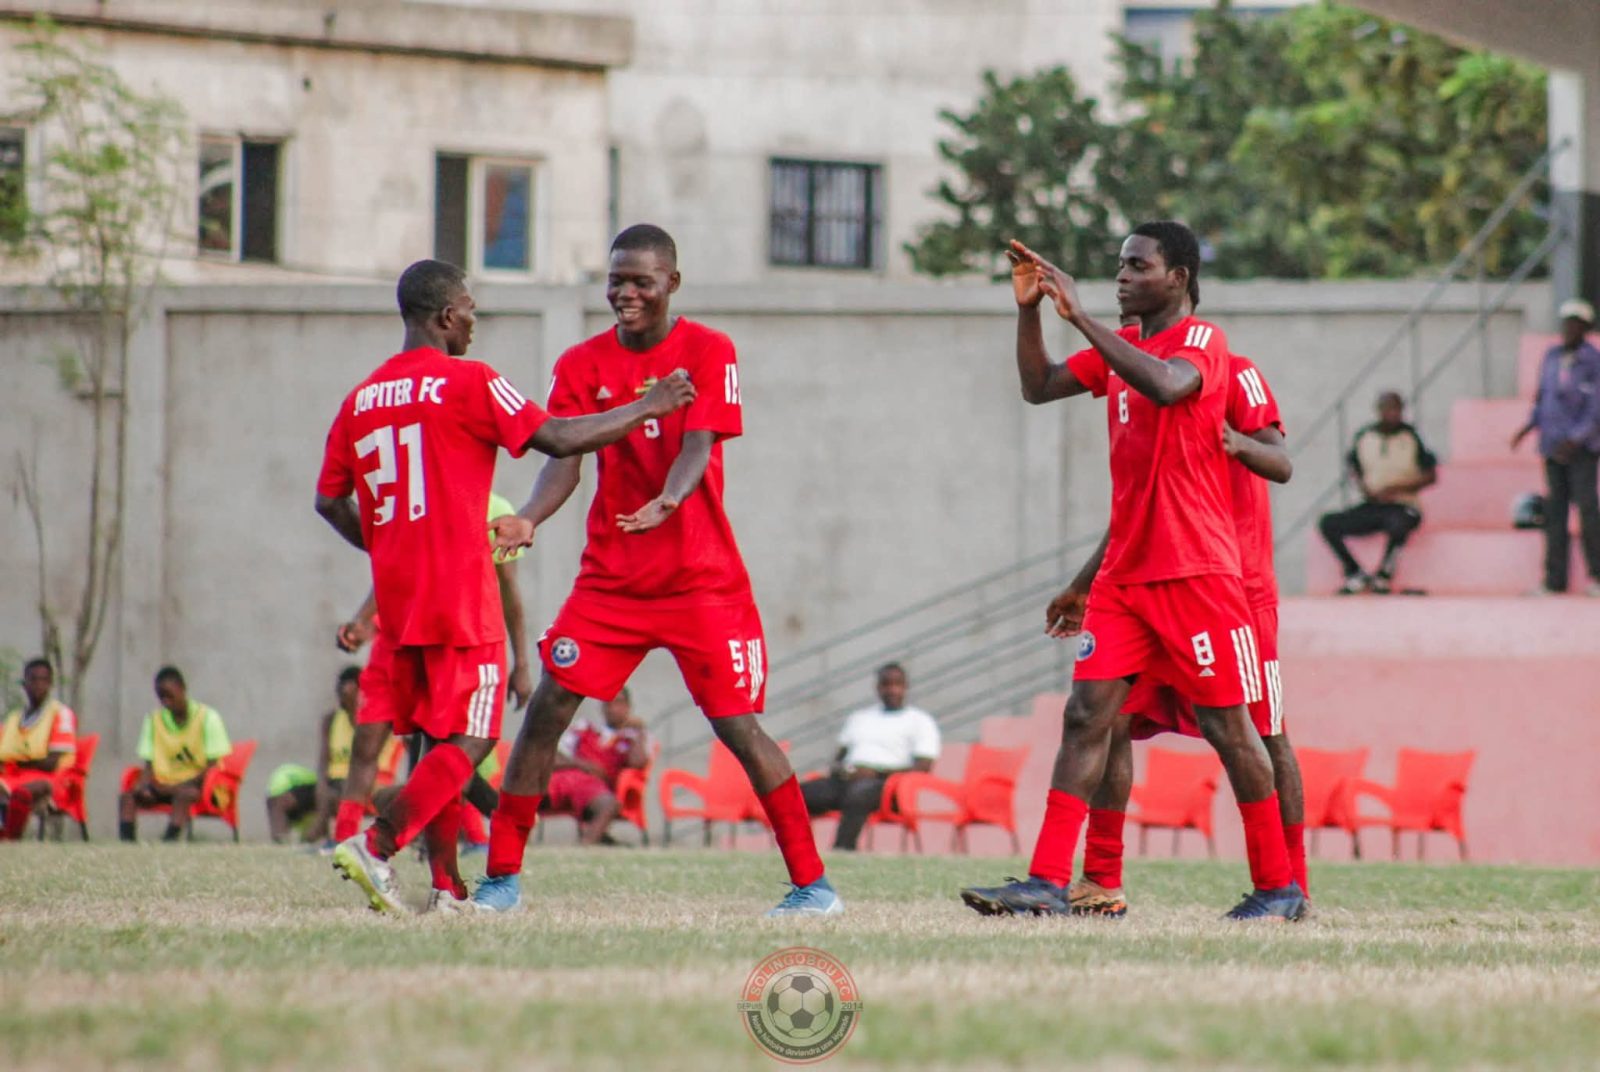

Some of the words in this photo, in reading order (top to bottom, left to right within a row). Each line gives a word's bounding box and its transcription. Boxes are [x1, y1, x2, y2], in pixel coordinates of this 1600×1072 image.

[353, 377, 414, 416] JUPITER
[418, 376, 447, 404] FC
[1118, 389, 1129, 424] 8
[644, 418, 660, 439] 5
[354, 422, 426, 526] 21
[728, 639, 745, 673] 5
[1191, 631, 1216, 666] 8
